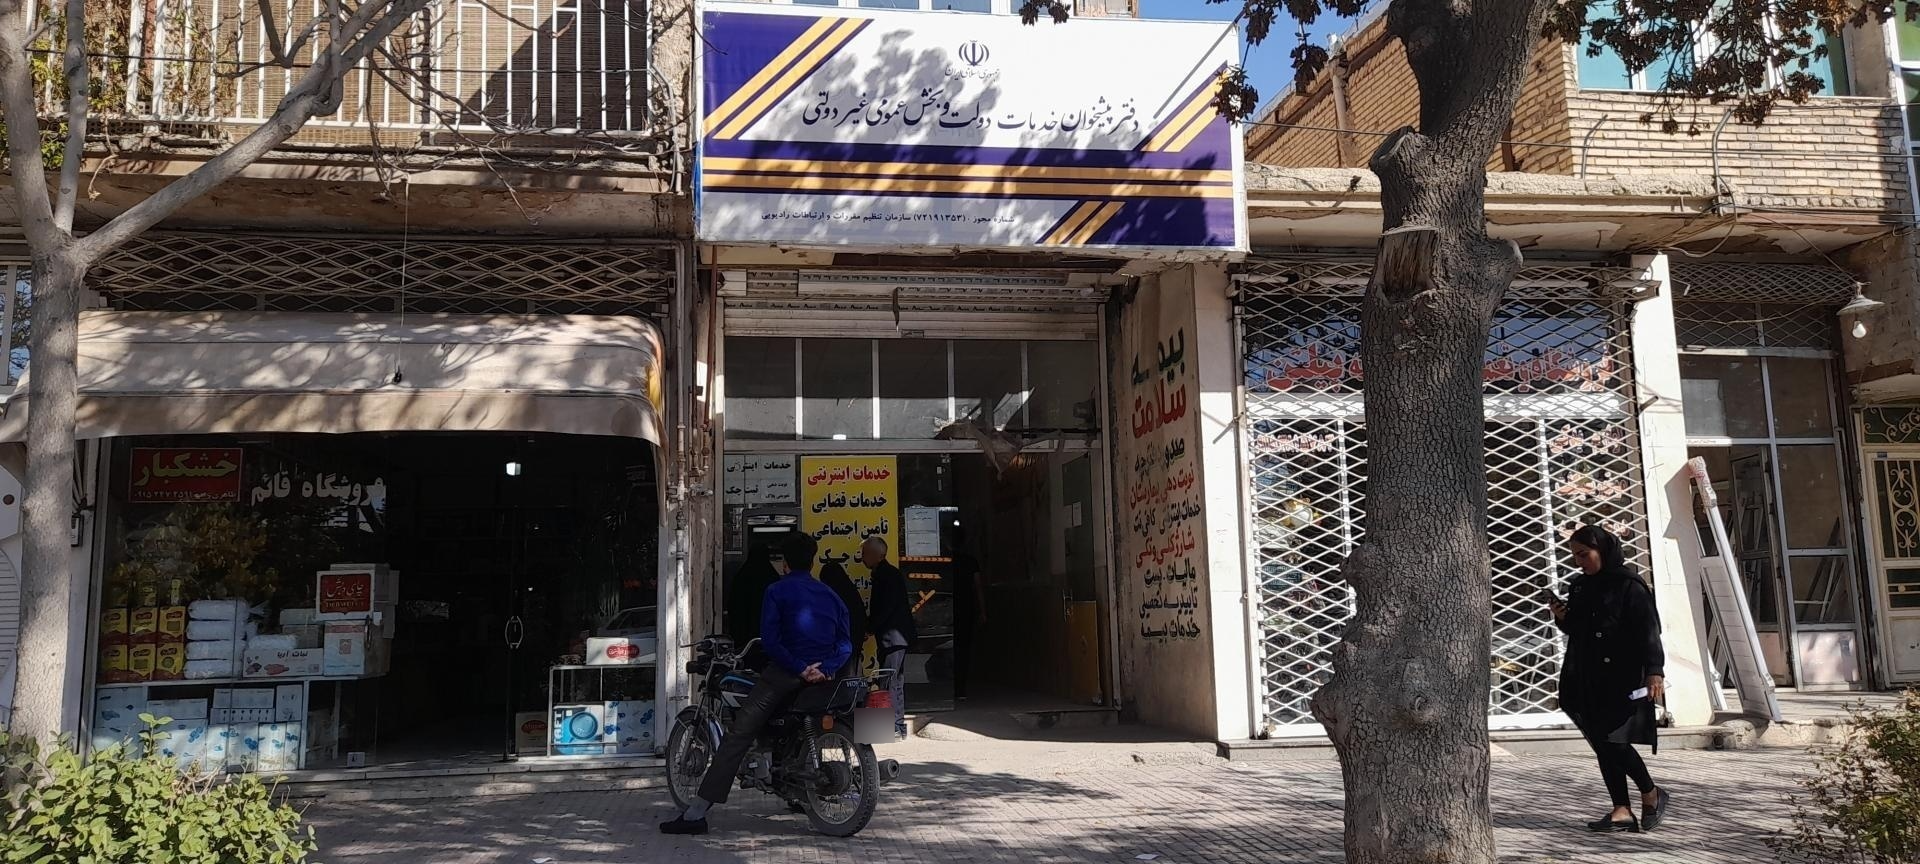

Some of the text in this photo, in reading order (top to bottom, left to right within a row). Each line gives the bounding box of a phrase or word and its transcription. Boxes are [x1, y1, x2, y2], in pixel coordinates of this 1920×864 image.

[944, 65, 961, 81] ایران
[802, 87, 1139, 136] دفتر پیشخوان خدمات دولت و بخش عمومی غیر دولتی
[761, 211, 789, 220] رادیویی
[792, 210, 825, 220] ارتباطات
[832, 211, 861, 222] مقررات
[863, 212, 882, 223] تنظیم
[884, 213, 911, 221] سازمان
[972, 215, 991, 224] مجوز
[993, 213, 1015, 223] شماره
[1131, 378, 1187, 440] سلامت
[134, 452, 238, 486] خشکبار
[726, 461, 792, 473] خدمات اینتری
[807, 464, 891, 486] خدمات اینترنتی
[1178, 461, 1195, 495] نوبت
[251, 470, 386, 507] فروشگاه قائم
[725, 484, 759, 496] ثبت چک
[1129, 479, 1160, 511] بیمارستان
[812, 491, 887, 514] خدمات قضایی
[1181, 494, 1201, 521] خدمات
[812, 519, 858, 541] اجتماعی
[860, 516, 889, 540] تأمین
[1156, 533, 1175, 566] کلی
[1174, 524, 1195, 558] شارژ
[1143, 557, 1196, 591] مالیات پست
[345, 580, 365, 597] چای
[1139, 590, 1163, 619] تحصیلی
[1140, 613, 1201, 645] خدمات بیمه
